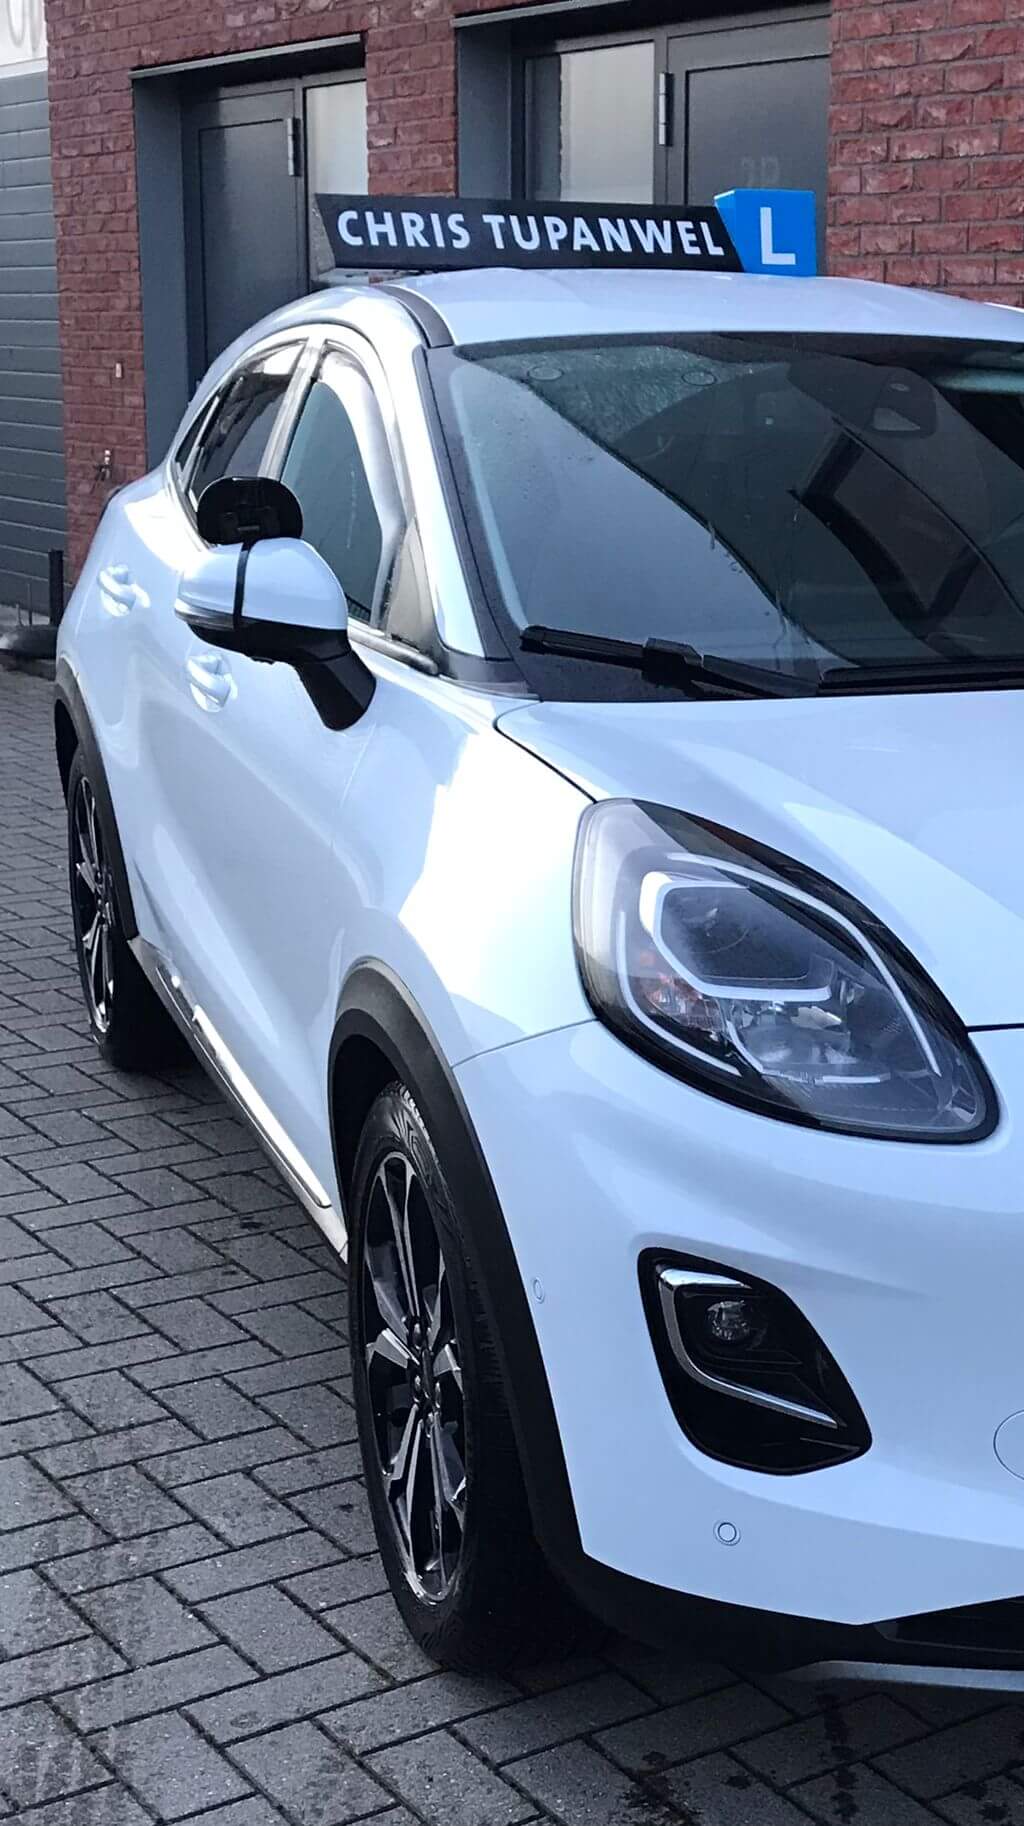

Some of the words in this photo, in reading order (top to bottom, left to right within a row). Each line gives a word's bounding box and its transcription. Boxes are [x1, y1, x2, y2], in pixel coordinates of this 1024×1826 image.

[336, 209, 471, 250] CHRIS
[482, 213, 725, 256] TUPANWEL
[760, 206, 796, 265] L
